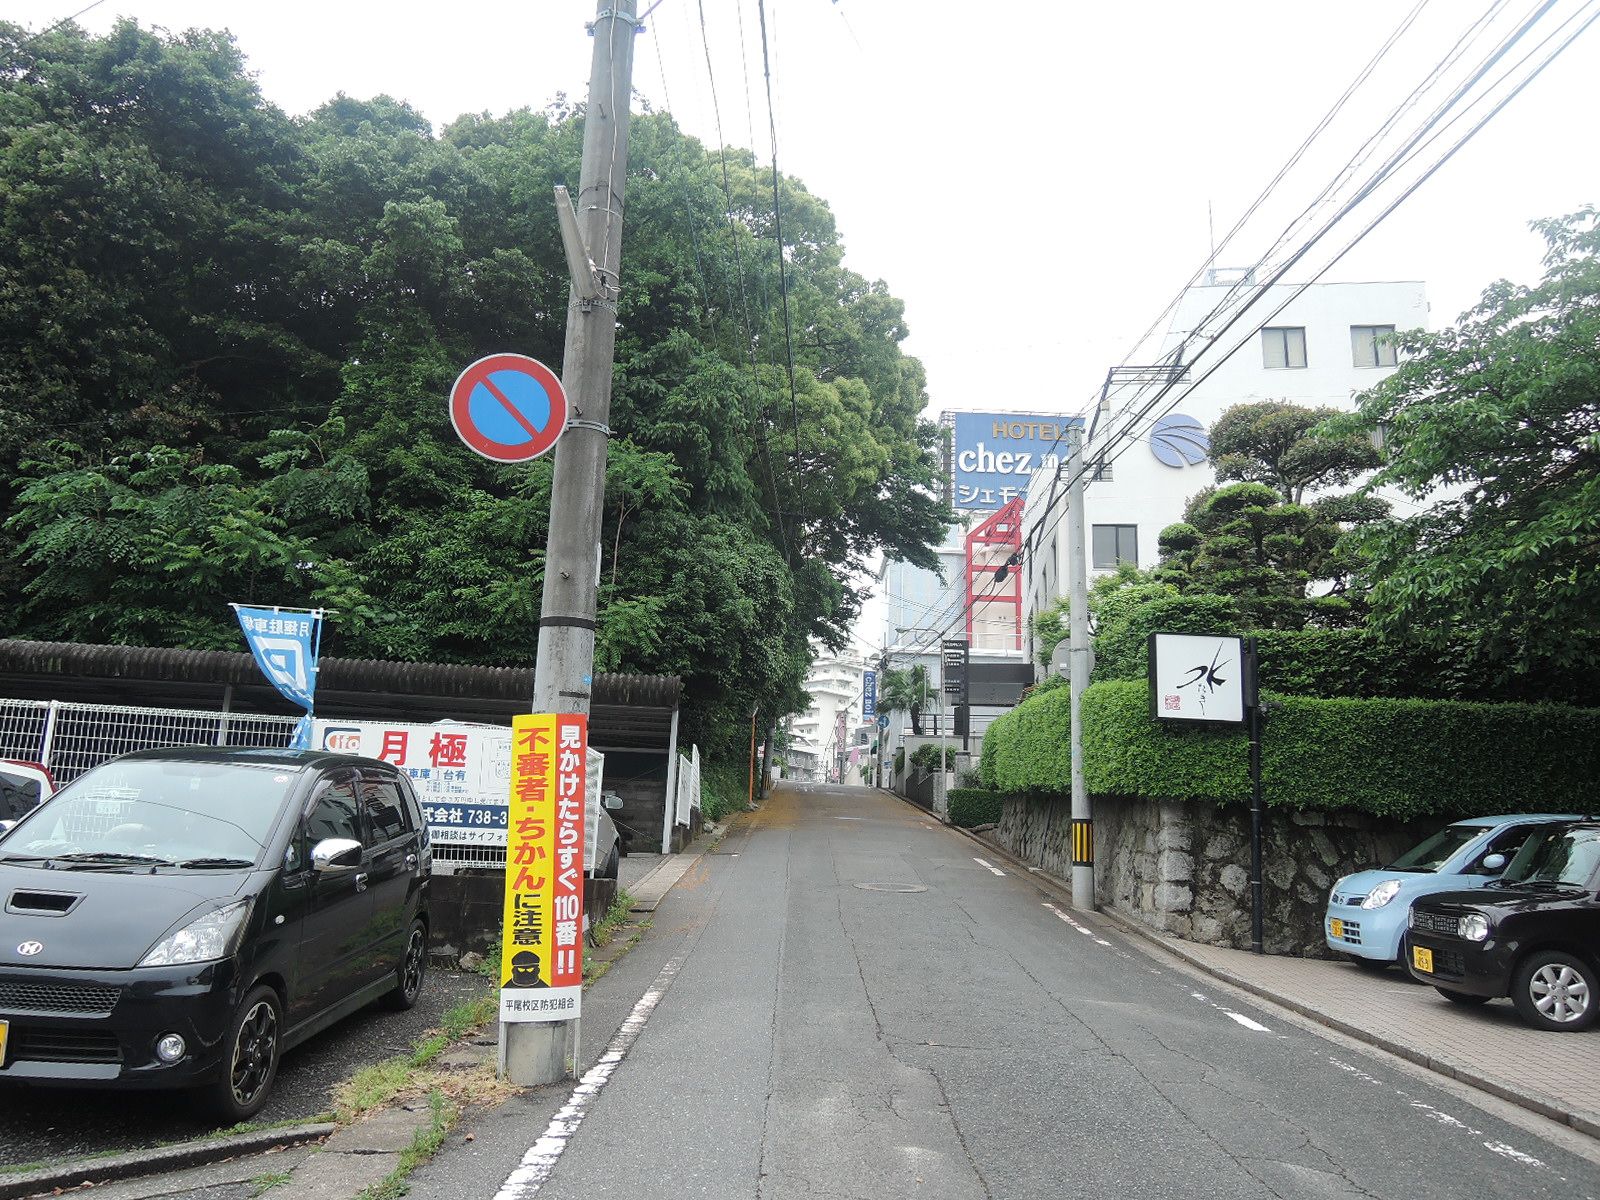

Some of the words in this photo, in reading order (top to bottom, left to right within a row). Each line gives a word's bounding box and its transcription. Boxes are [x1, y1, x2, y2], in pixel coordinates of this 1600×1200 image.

[991, 419, 1068, 442] HOTEL
[958, 441, 1033, 475] chez
[958, 484, 1028, 505] シェモ
[467, 809, 508, 825] 738-3
[505, 997, 575, 1012] 平尾校区防犯組合
